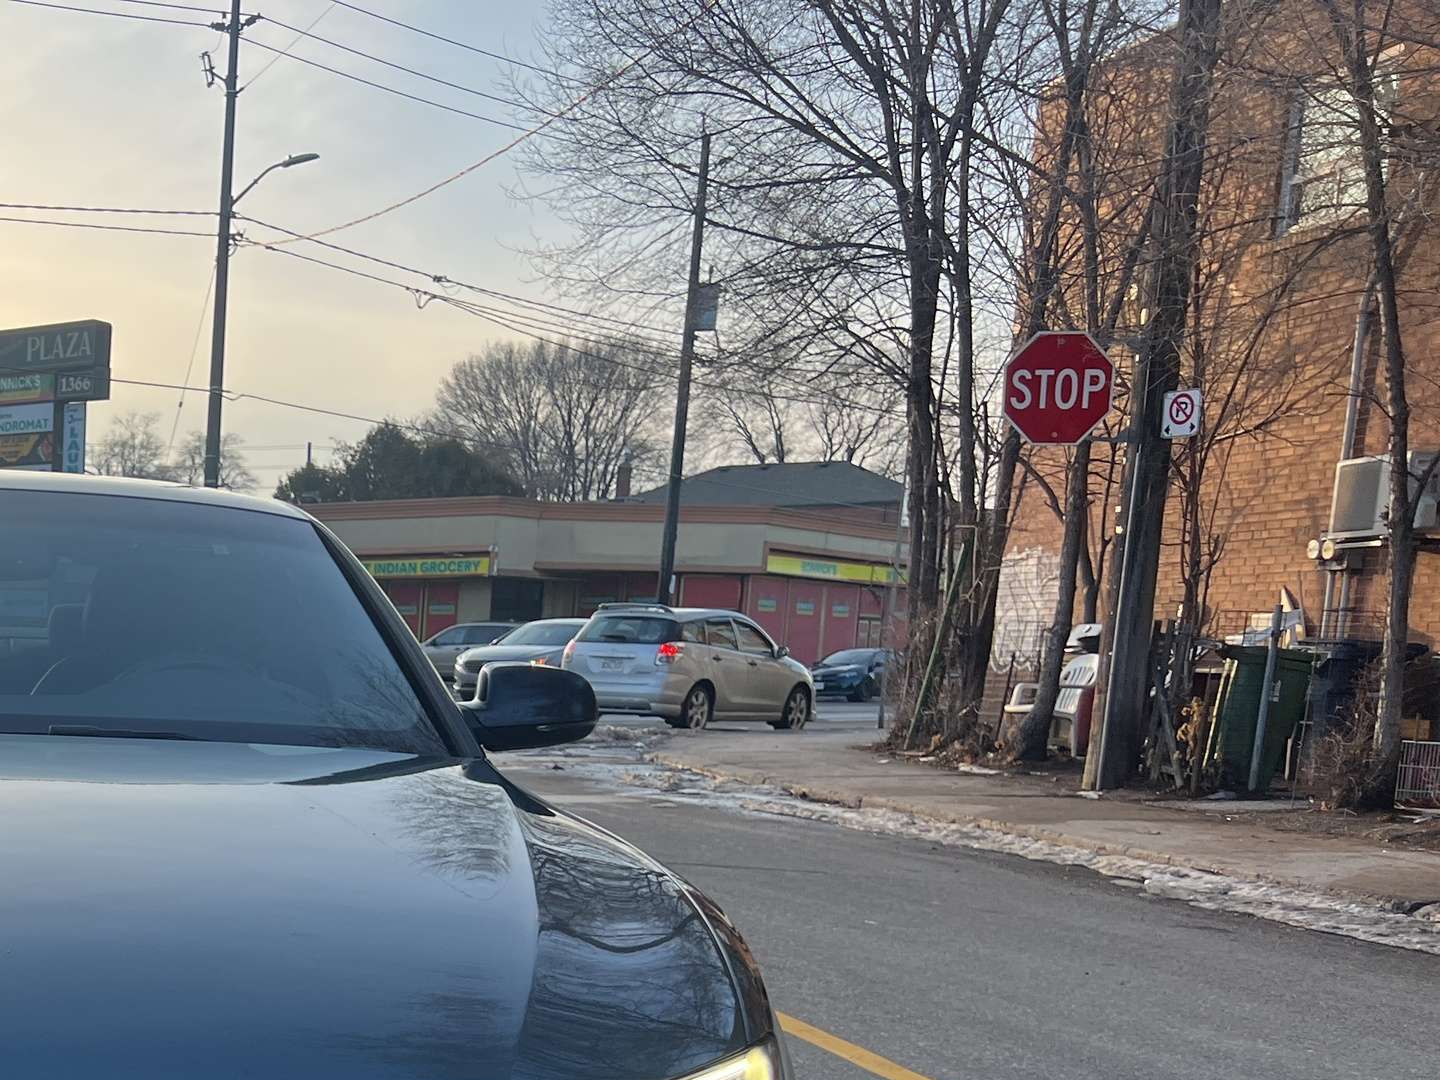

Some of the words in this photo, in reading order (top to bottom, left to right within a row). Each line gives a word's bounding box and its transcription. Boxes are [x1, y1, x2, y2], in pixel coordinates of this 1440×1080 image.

[26, 331, 92, 362] PLAZA
[61, 376, 91, 392] 1366
[1010, 368, 1106, 410] STOP
[374, 562, 417, 574] INDIAN
[420, 560, 481, 573] GROCERY
